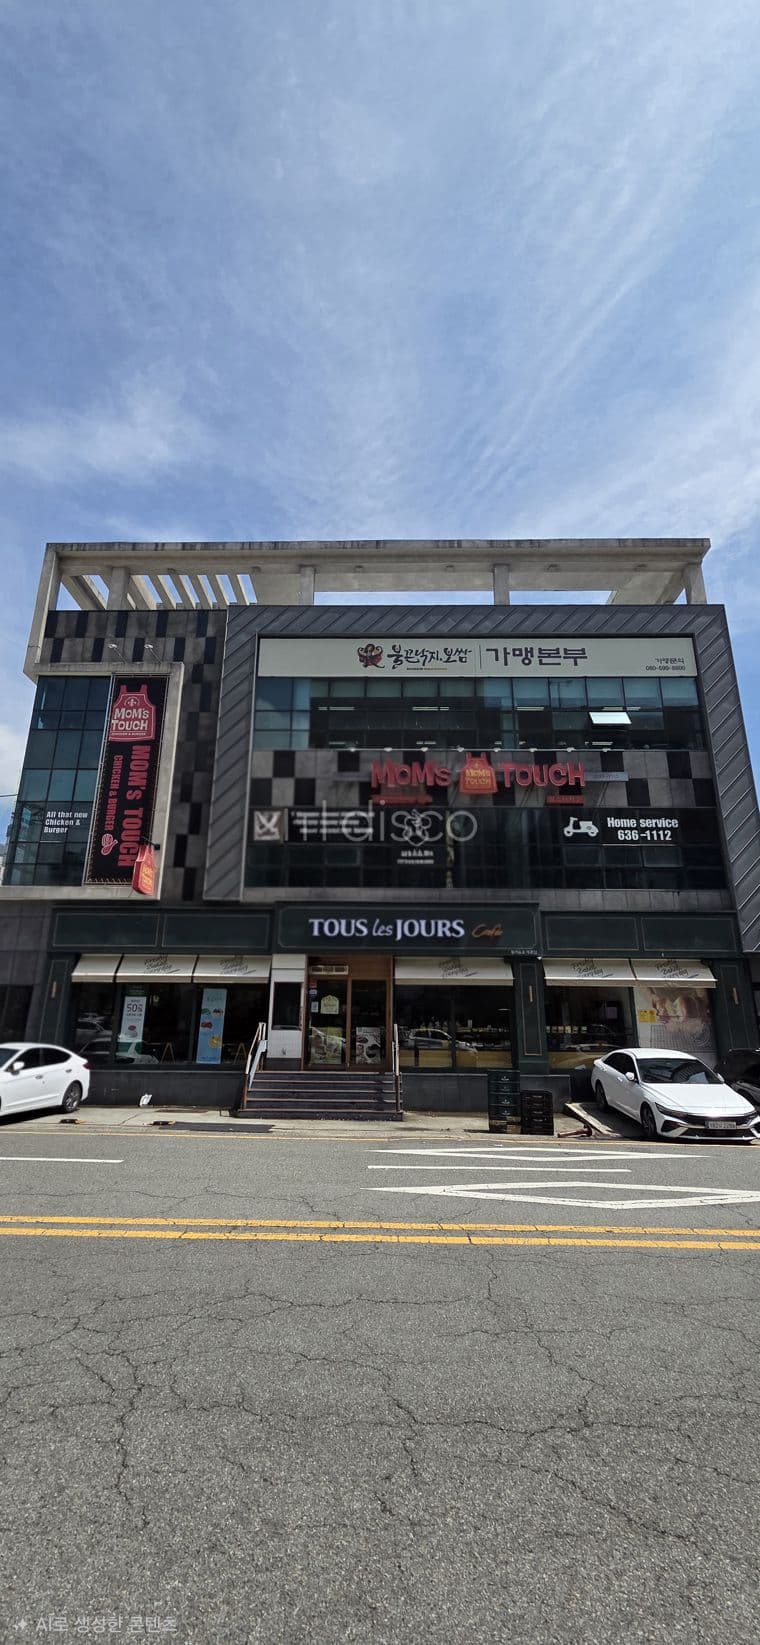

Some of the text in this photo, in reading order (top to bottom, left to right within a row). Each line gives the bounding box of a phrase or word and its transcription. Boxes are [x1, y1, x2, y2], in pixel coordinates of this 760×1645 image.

[486, 646, 588, 666] 가맹본부
[111, 719, 149, 731] TOUCH
[110, 755, 123, 790] CHICKEN
[104, 798, 118, 831] BURGER
[607, 817, 679, 828] Home service
[118, 807, 144, 867] TOUCH
[617, 829, 672, 841] 636-1112
[309, 918, 368, 937] TOUS
[372, 918, 393, 937] les
[395, 919, 465, 941] JOURS
